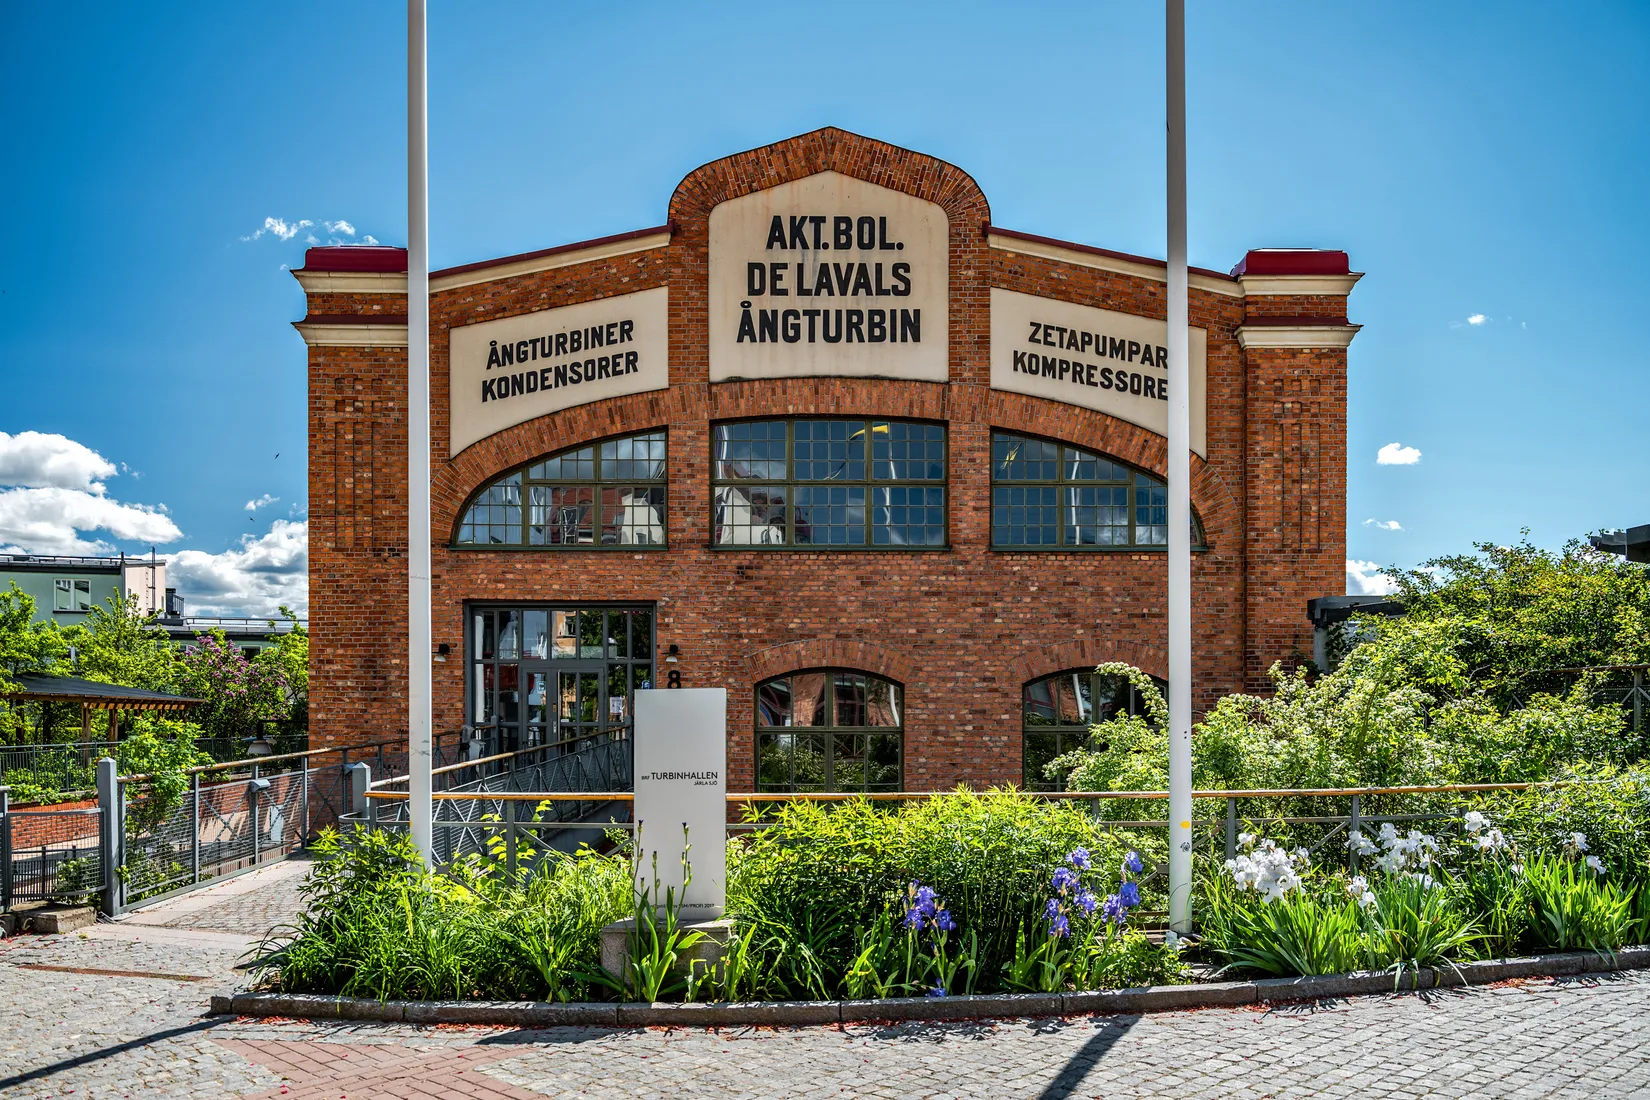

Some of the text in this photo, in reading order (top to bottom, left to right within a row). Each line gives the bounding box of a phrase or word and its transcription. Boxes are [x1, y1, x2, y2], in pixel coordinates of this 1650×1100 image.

[748, 262, 911, 297] DE LAVALS
[486, 319, 634, 370] ÅNGTURBINER
[736, 300, 921, 343] ÅNGTURBIN
[1028, 321, 1168, 370] ZETAPUMPAR
[482, 351, 639, 403] KONDENSORER
[1013, 350, 1168, 401] KOMPRESSORE
[667, 669, 681, 689] 8
[651, 771, 718, 780] TURBINHALLEN
